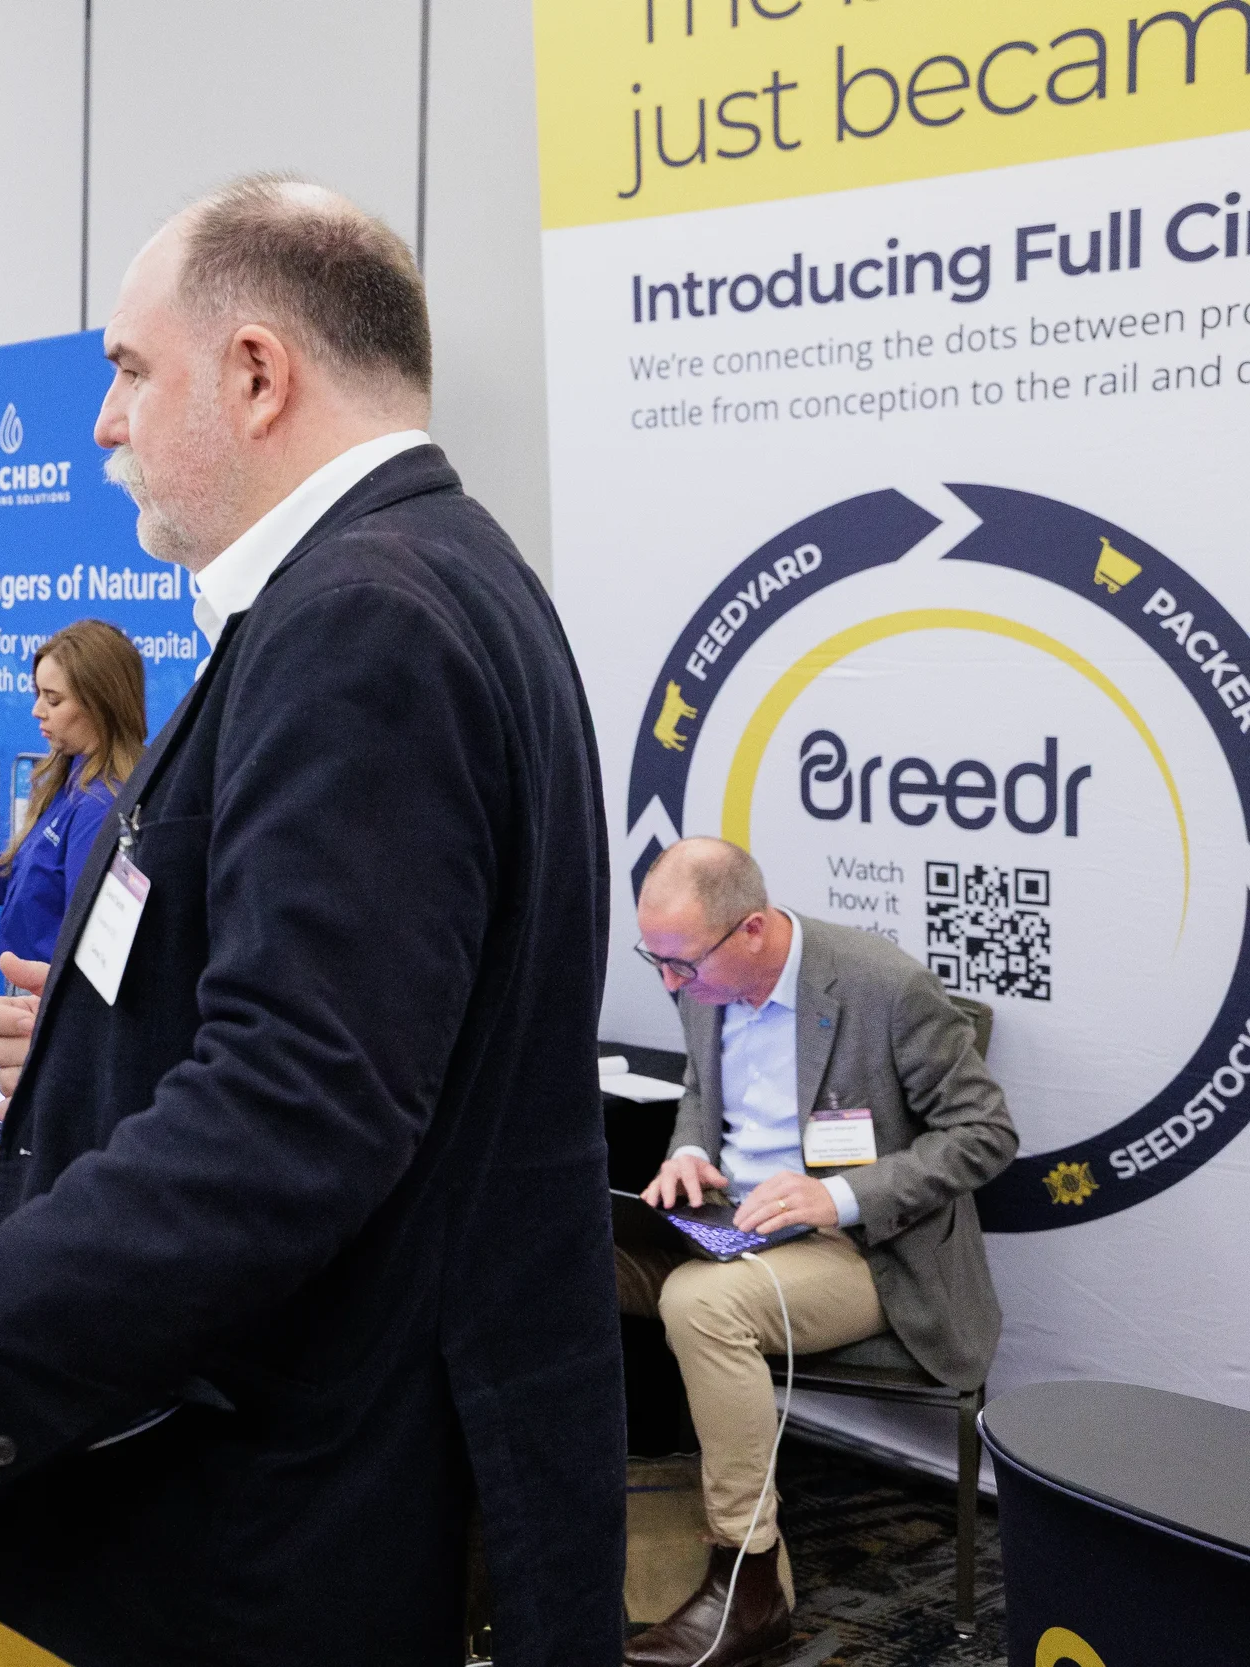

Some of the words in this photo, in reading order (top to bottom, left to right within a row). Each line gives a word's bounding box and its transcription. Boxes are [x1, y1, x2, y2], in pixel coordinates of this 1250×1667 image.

[617, 70, 802, 199] just
[632, 237, 991, 323] Introducing
[1015, 208, 1142, 282] Full
[1165, 191, 1250, 263] Ci
[629, 352, 704, 381] We're
[713, 337, 874, 372] connecting
[883, 329, 934, 361] the
[945, 324, 1018, 354] dots
[1030, 309, 1185, 346] between
[631, 400, 702, 430] cattle
[713, 396, 779, 425] from
[789, 382, 959, 421] conception
[971, 379, 1004, 405] to
[1016, 371, 1071, 402] the
[1084, 362, 1137, 397] rail
[1151, 355, 1222, 392] and
[56, 563, 84, 601] of
[88, 564, 181, 601] Natural
[685, 543, 823, 681] FEEDYARD
[133, 629, 198, 665] capital
[827, 854, 905, 884] Watch
[828, 885, 879, 912] how
[885, 891, 900, 916] it
